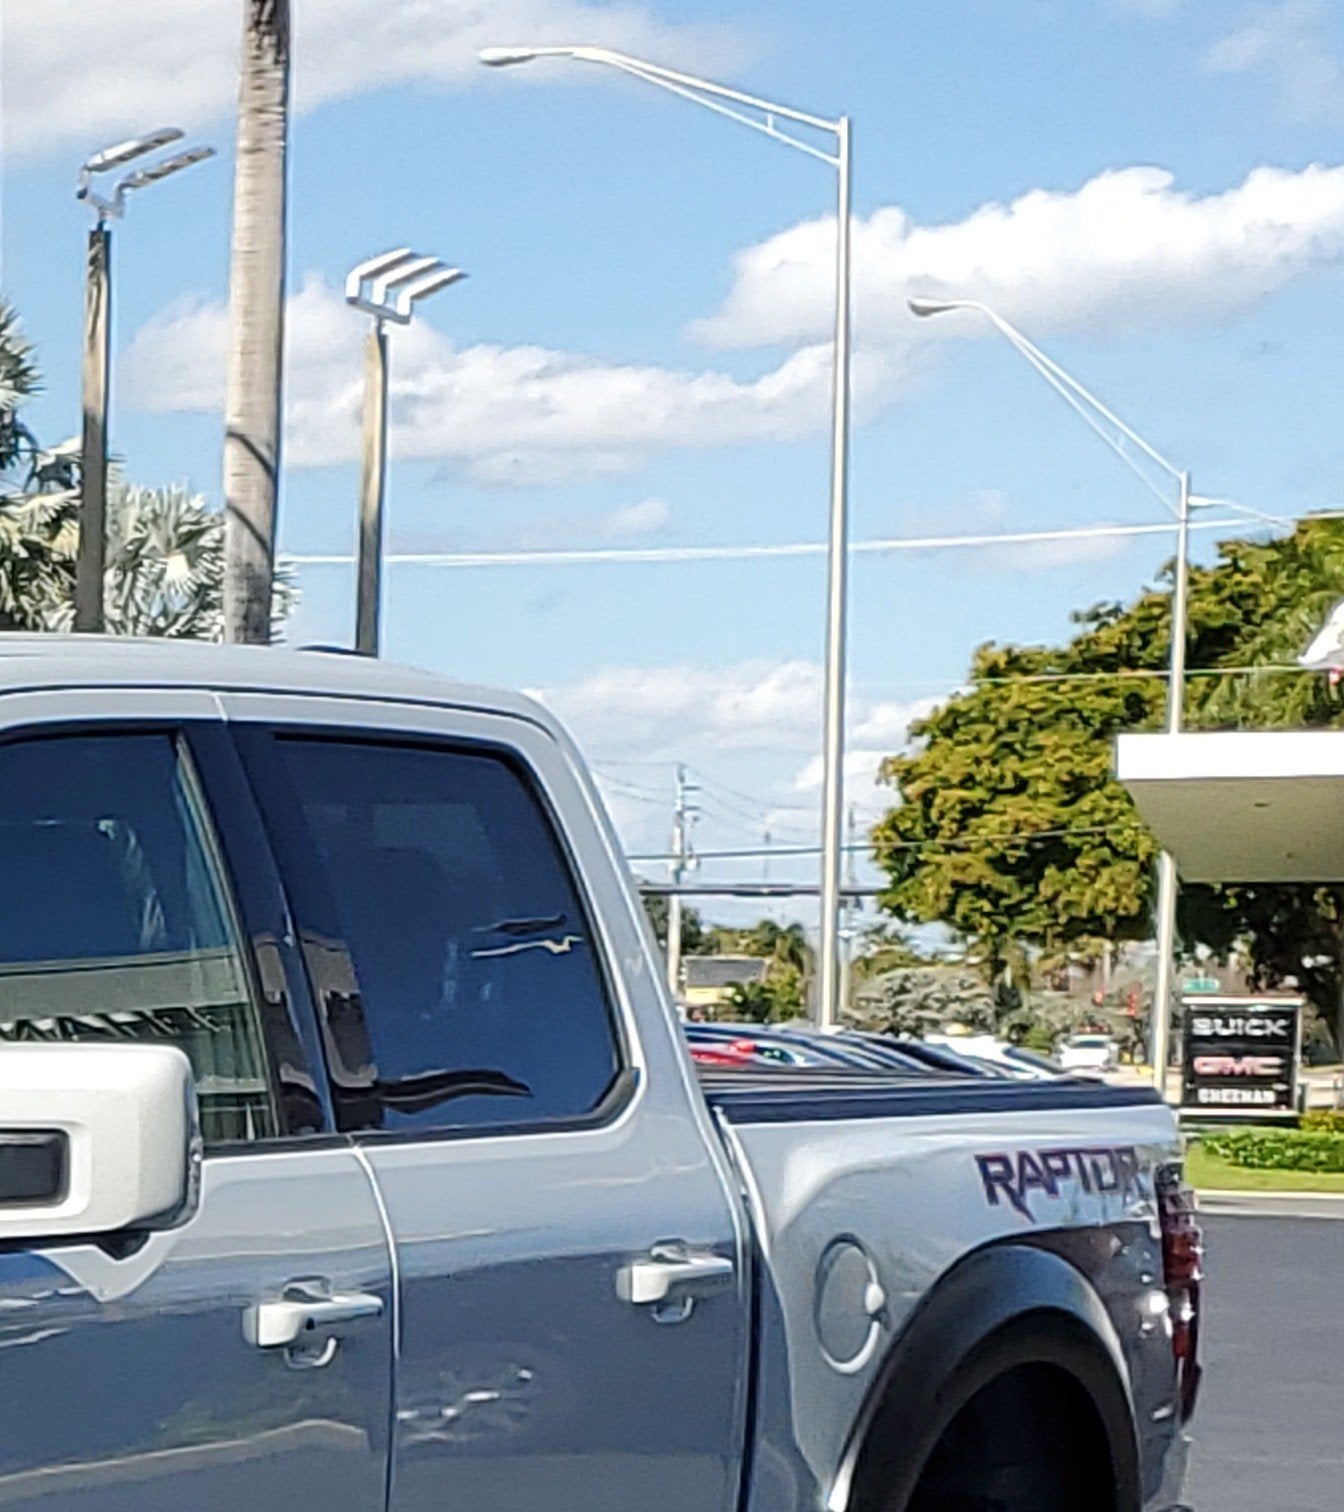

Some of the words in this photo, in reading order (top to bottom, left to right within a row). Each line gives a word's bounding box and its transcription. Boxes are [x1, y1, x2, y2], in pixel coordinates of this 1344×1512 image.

[1191, 1018, 1291, 1037] BUICK
[1193, 1056, 1285, 1076] GMC
[974, 1145, 1150, 1224] RAPTOR
